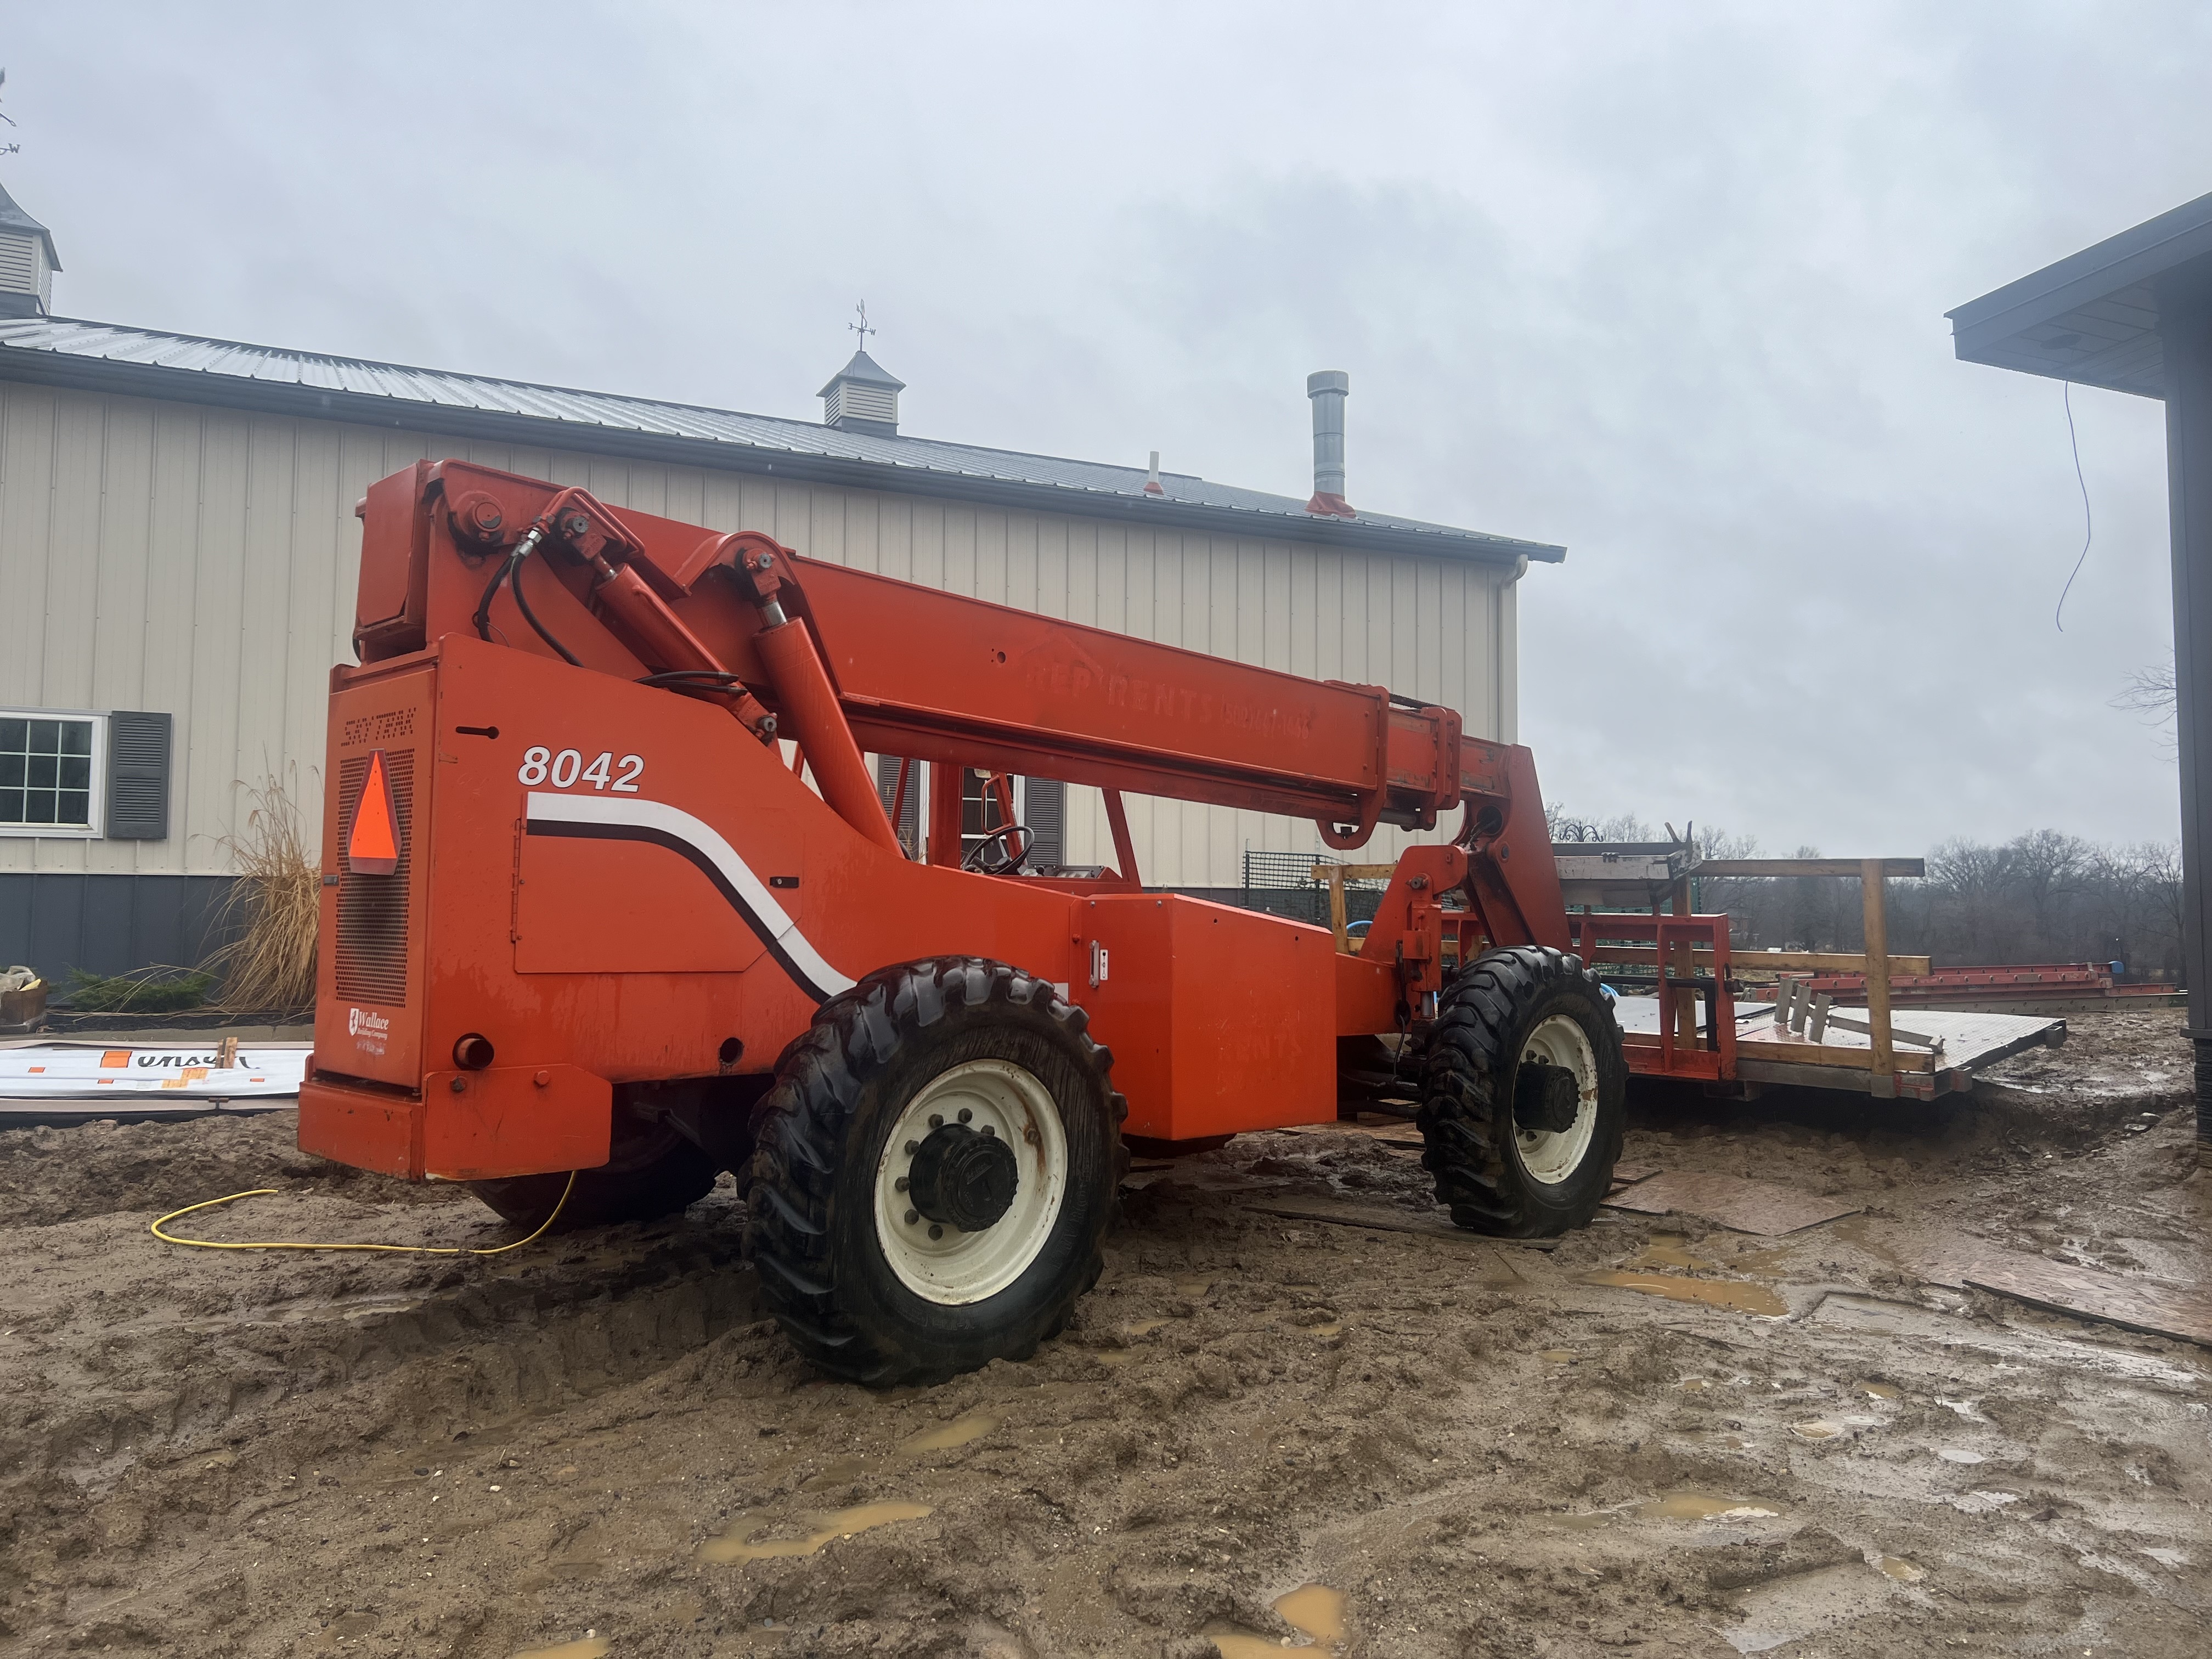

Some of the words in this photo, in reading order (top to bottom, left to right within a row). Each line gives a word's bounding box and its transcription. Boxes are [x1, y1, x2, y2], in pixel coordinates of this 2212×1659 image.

[518, 746, 645, 792] 8042
[359, 1011, 389, 1030] Wallace
[371, 1029, 388, 1040] Company
